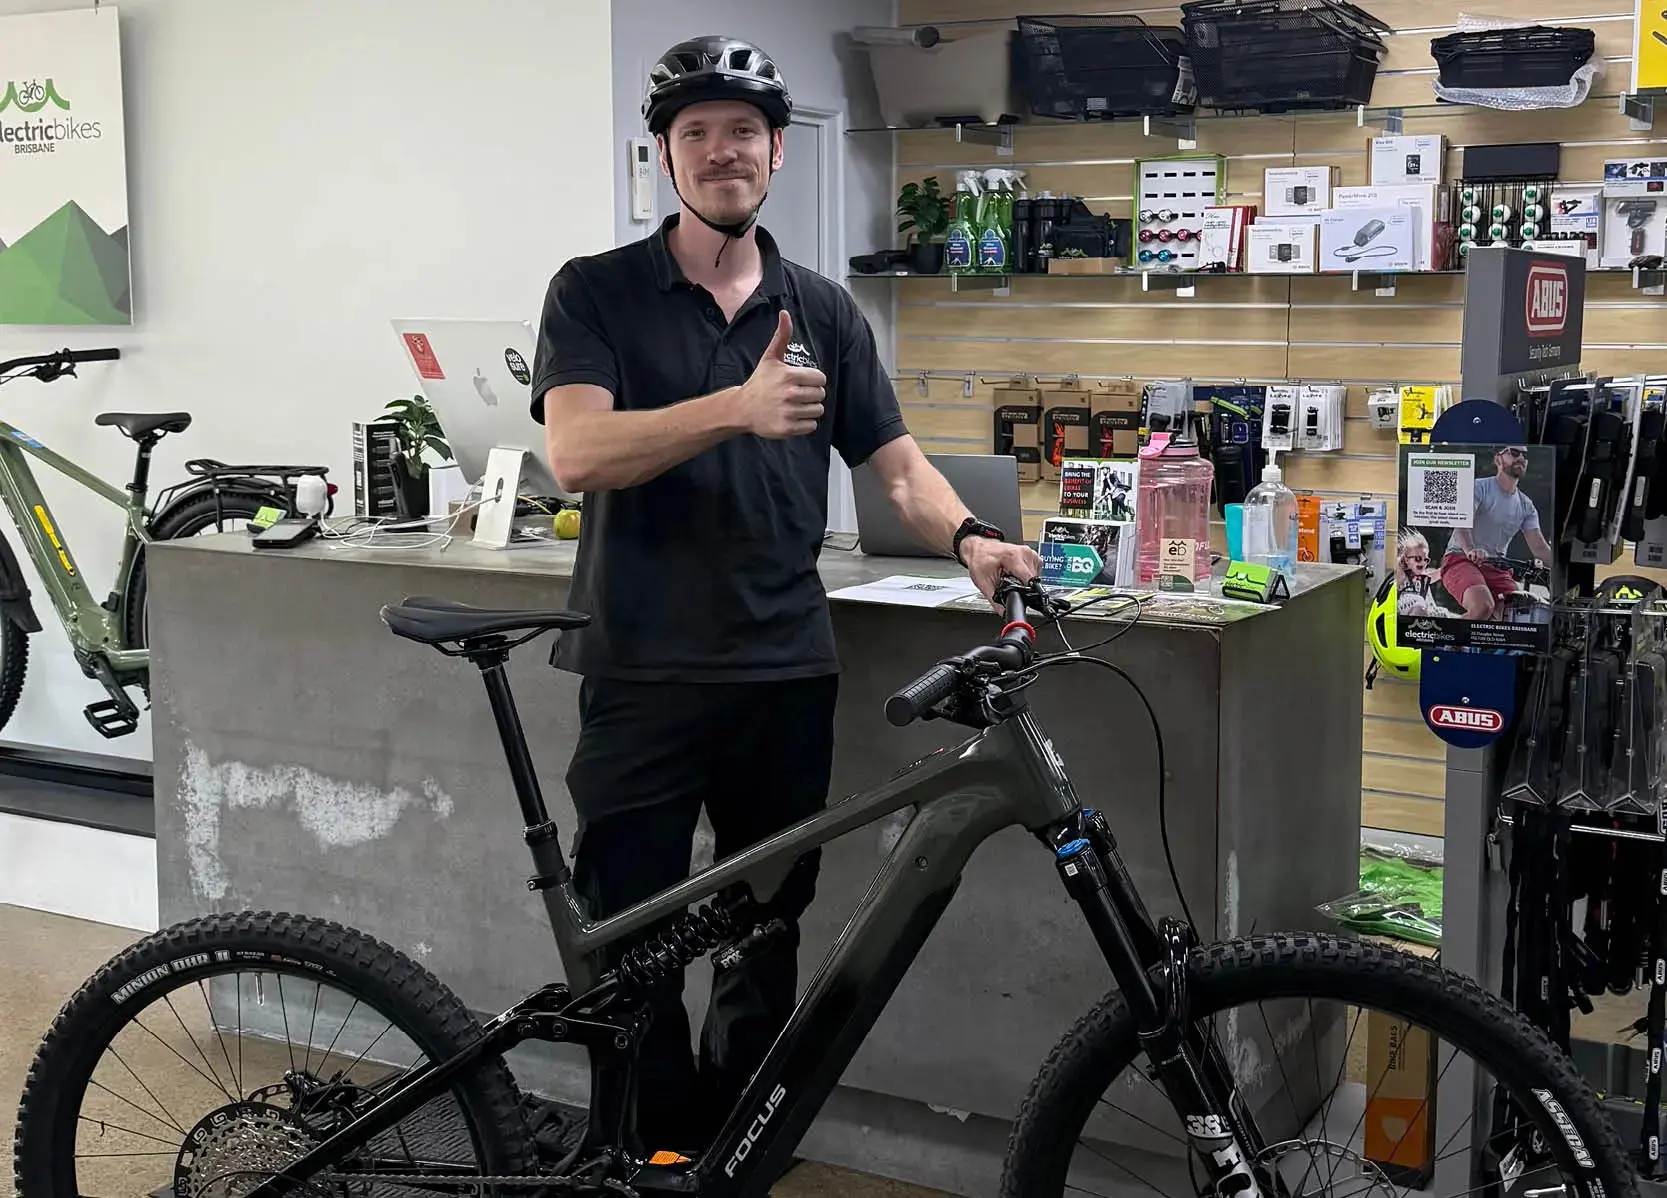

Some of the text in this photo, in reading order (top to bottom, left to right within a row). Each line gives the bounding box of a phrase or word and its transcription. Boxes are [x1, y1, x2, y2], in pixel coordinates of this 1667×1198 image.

[0, 116, 102, 143] lectricbikes
[14, 143, 55, 154] BRISBANE
[1531, 279, 1564, 319] ABUS
[1404, 630, 1456, 641] electricbikes
[1438, 709, 1494, 728] ABUS
[720, 950, 744, 969] FOX
[110, 964, 170, 1004] MINION
[171, 953, 209, 971] DHR
[1652, 1050, 1660, 1071] ABUS
[724, 1083, 787, 1179] FOCUS
[1531, 1088, 1596, 1169] ASSEGAI
